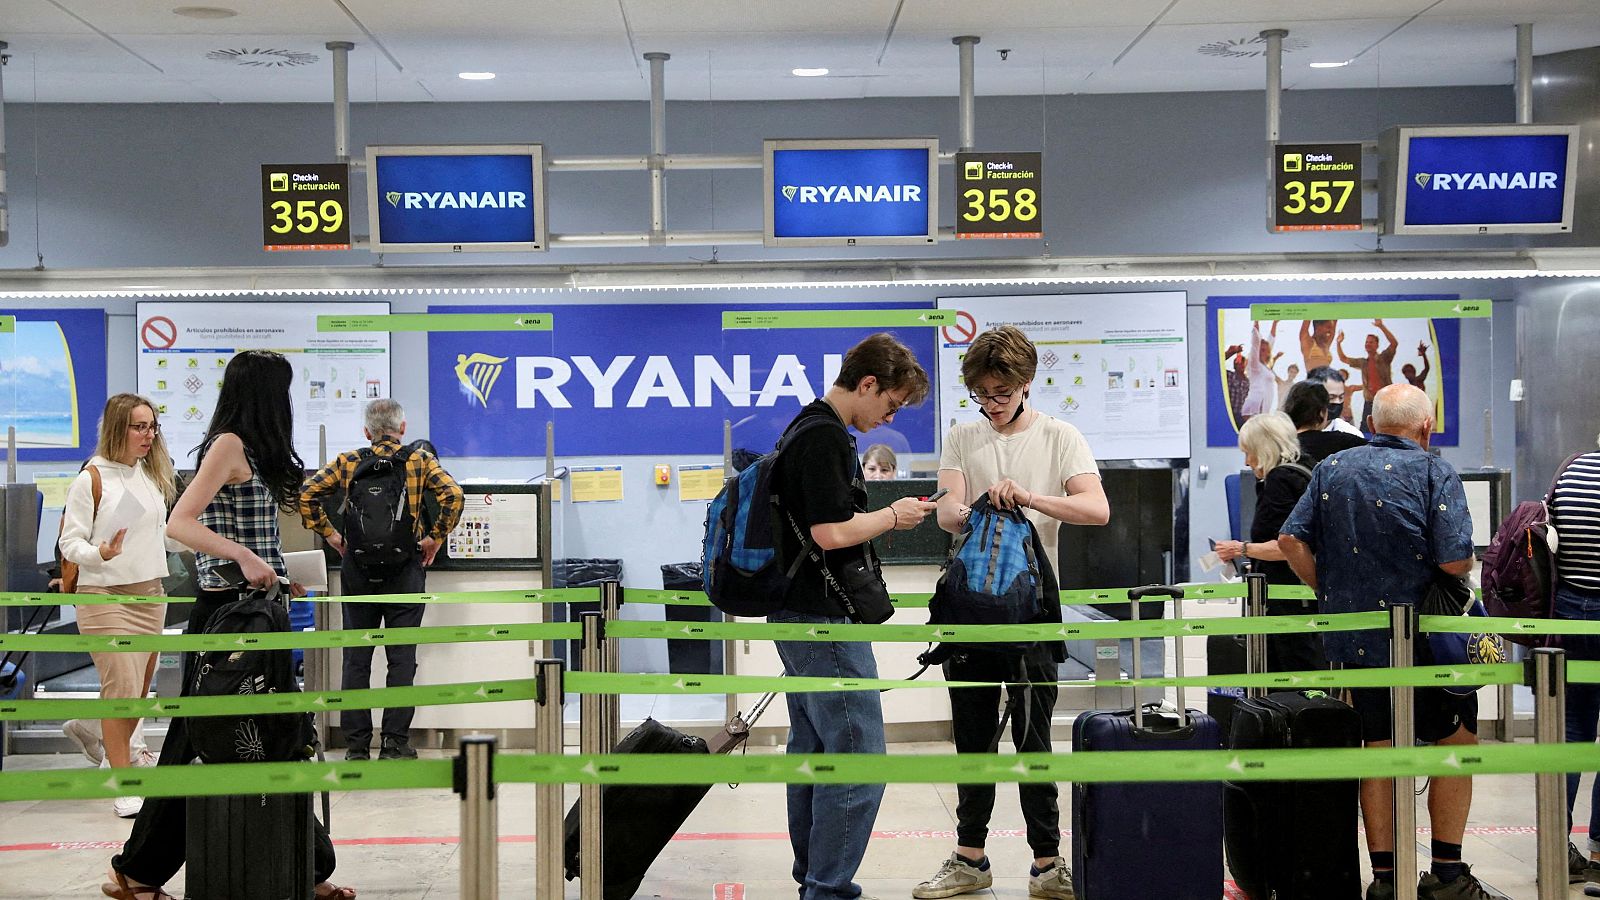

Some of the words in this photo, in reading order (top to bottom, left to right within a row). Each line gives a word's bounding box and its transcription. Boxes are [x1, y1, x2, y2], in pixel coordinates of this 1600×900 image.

[1305, 153, 1333, 162] Check-in
[986, 161, 1014, 170] Check-in
[1305, 162, 1354, 171] Facturación
[292, 173, 319, 182] Check-in
[987, 170, 1034, 179] Facturación
[1433, 171, 1558, 191] RYANAIR
[292, 181, 340, 191] Facturación
[800, 184, 921, 203] RYANAIR
[1283, 180, 1355, 214] 357
[404, 190, 526, 210] RYANAIR
[962, 187, 1037, 222] 358
[270, 199, 343, 234] 359
[1462, 305, 1480, 313] aena
[928, 313, 945, 321] aena
[524, 318, 541, 326] aena
[517, 353, 842, 408] RYANAI
